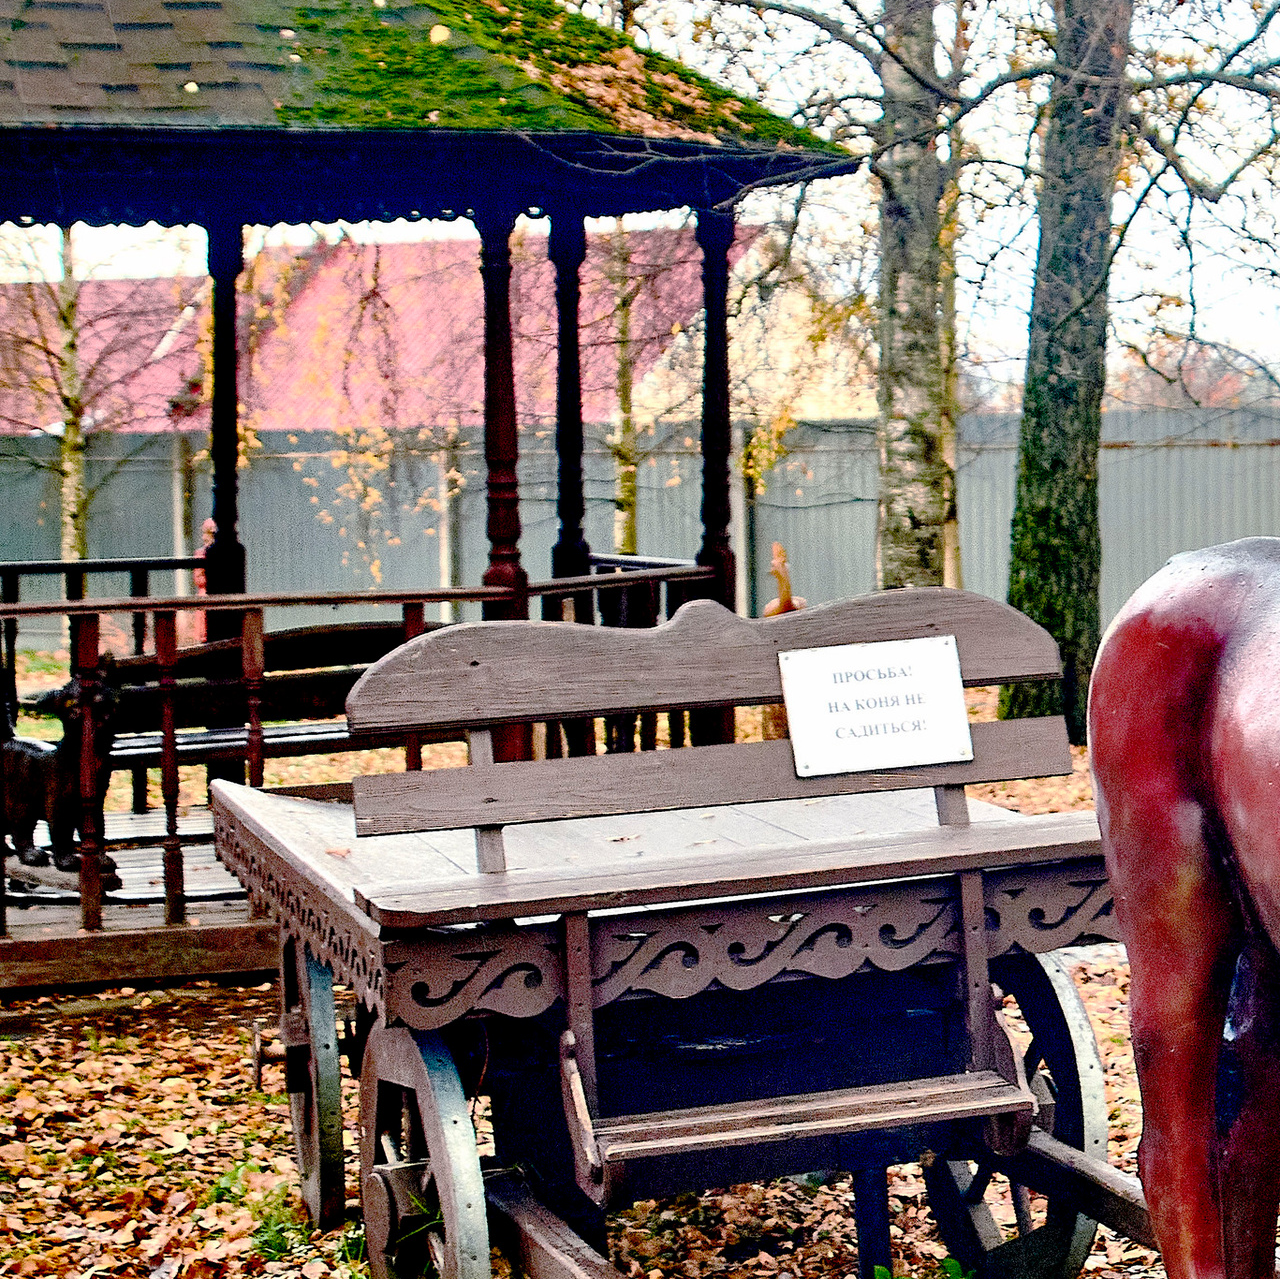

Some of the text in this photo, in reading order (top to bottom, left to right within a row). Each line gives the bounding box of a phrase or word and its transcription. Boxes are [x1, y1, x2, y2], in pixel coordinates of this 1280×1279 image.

[832, 665, 913, 684] ПРОСЬБА!
[828, 692, 927, 713] НА КОНЯ НЕ
[835, 719, 927, 739] САДИТЬСЯ!
